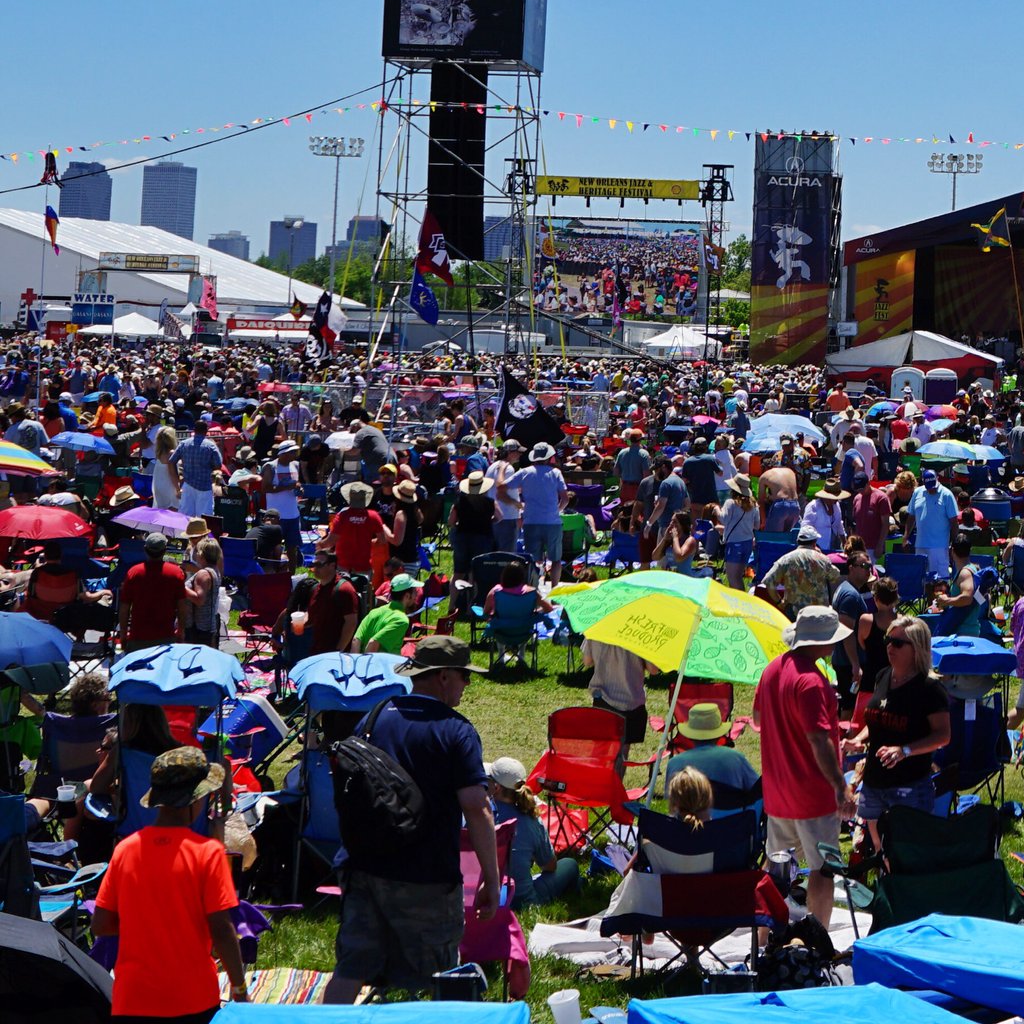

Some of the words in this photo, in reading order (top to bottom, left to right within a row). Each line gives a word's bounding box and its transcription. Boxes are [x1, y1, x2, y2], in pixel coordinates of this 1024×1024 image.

[579, 178, 595, 186] NEW
[597, 178, 627, 187] ORLEANS
[629, 179, 646, 188] JAZZ
[767, 176, 822, 187] ACURA
[579, 187, 616, 196] HERITAGE
[620, 188, 653, 197] FESTIVAL
[74, 294, 115, 303] WATER
